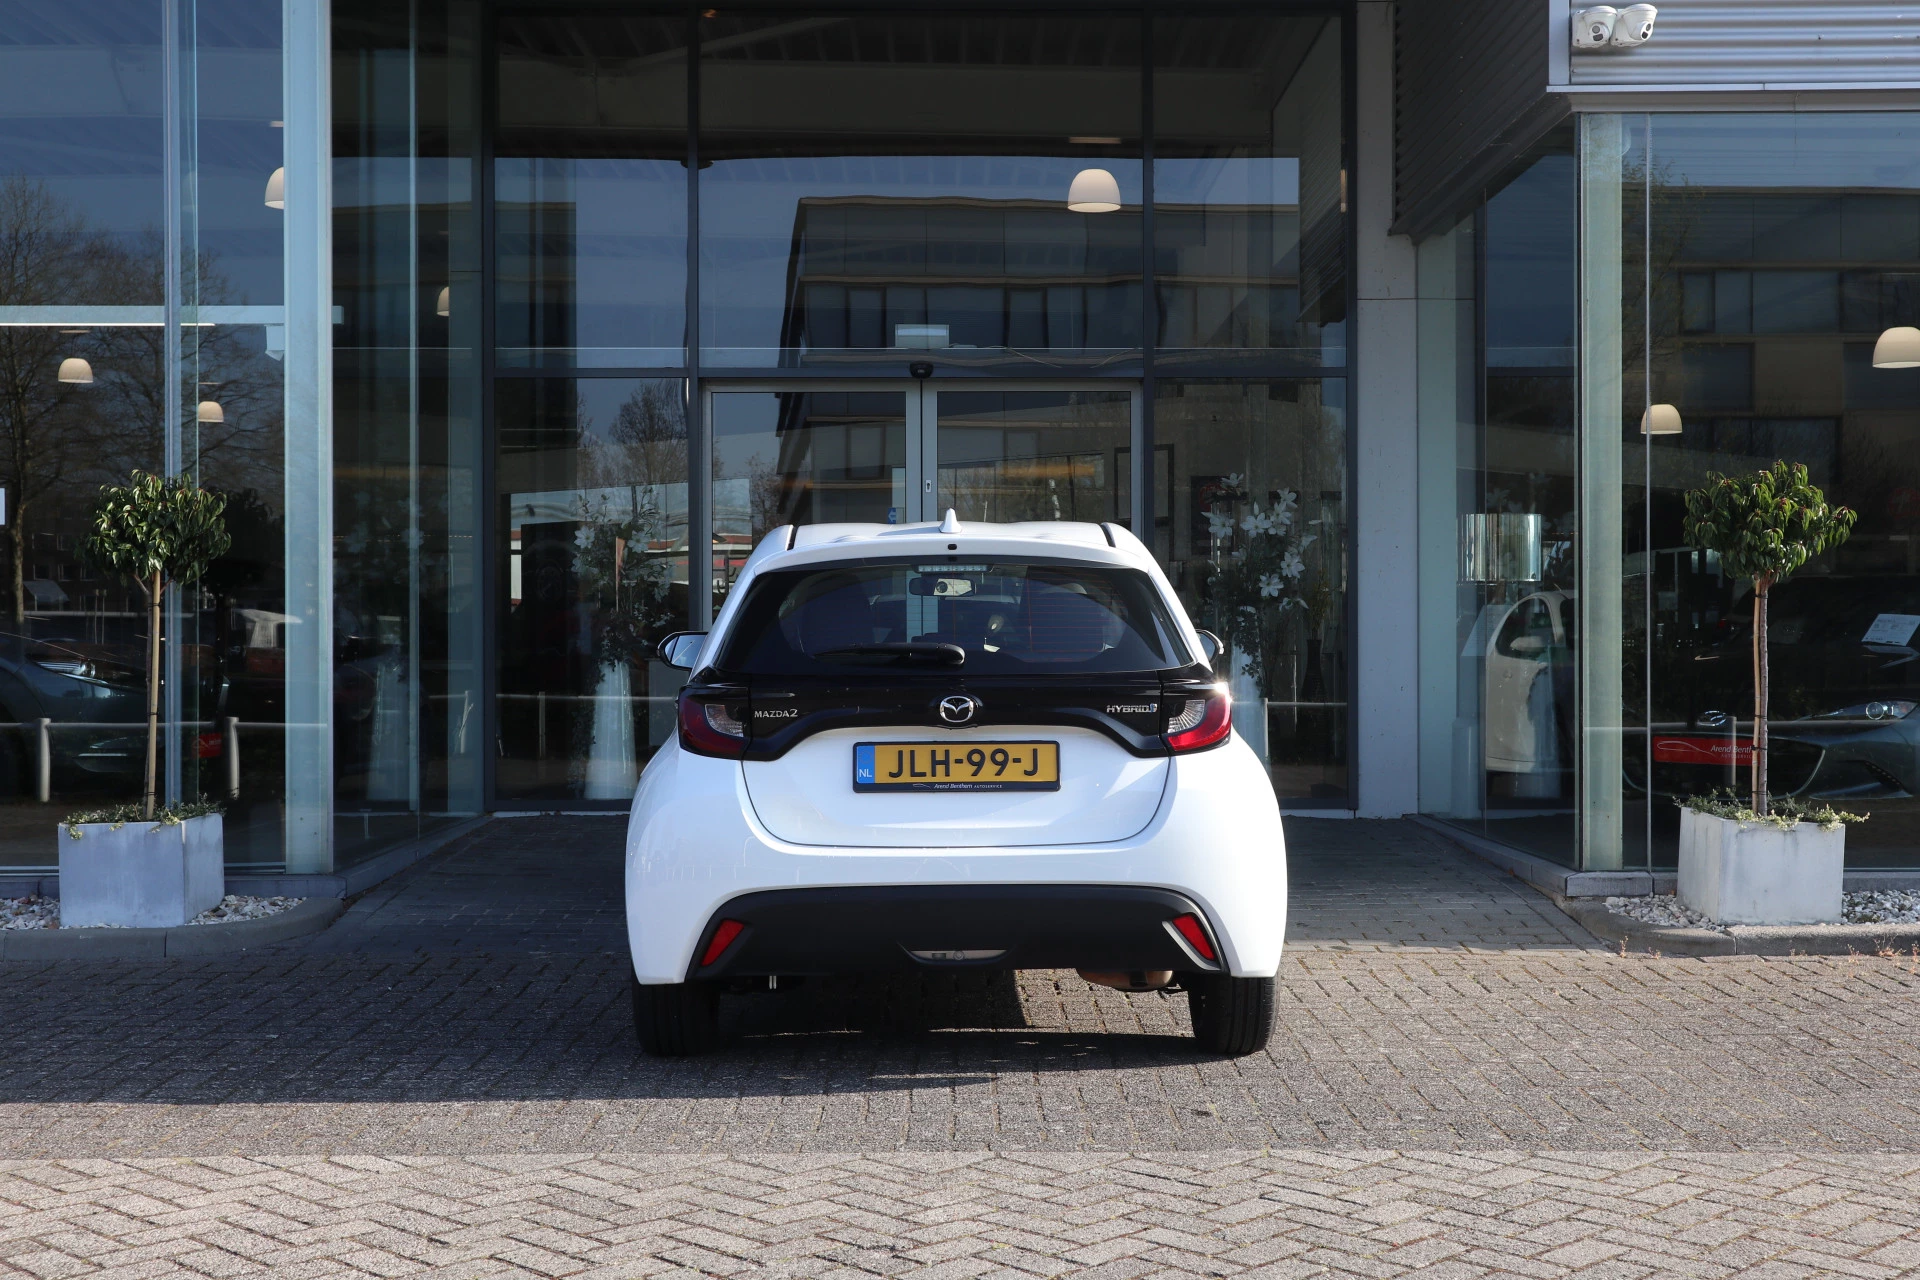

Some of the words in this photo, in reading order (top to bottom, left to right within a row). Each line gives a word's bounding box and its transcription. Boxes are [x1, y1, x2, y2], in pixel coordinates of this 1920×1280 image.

[754, 708, 798, 718] MAZDA2
[1106, 704, 1150, 713] HYBRID
[1710, 744, 1732, 753] Arend
[888, 748, 1038, 778] JLH-99-J
[859, 768, 873, 778] NL
